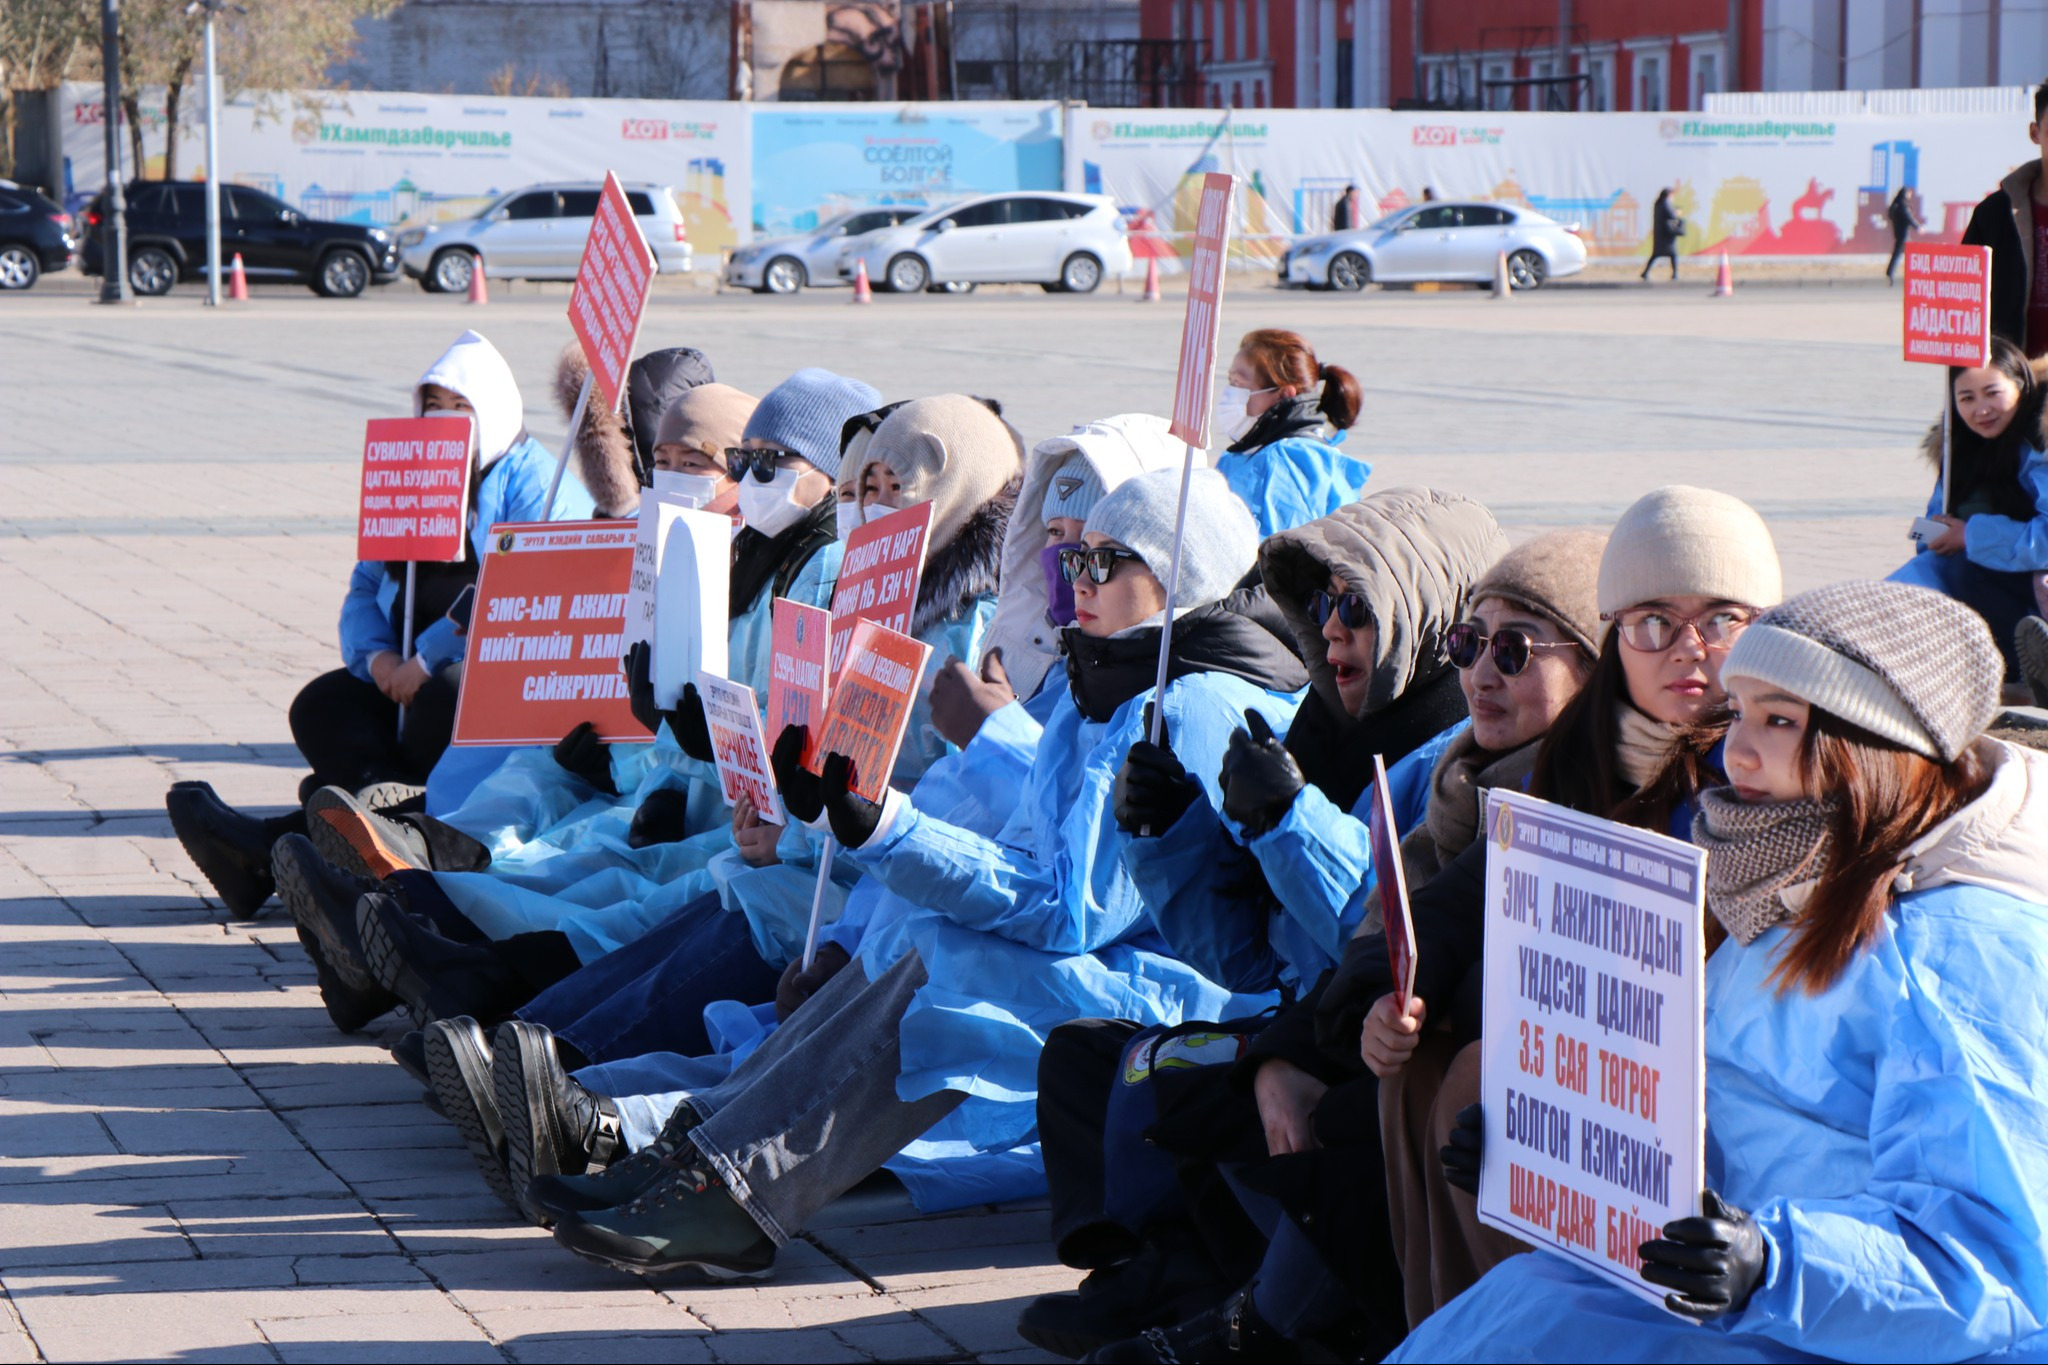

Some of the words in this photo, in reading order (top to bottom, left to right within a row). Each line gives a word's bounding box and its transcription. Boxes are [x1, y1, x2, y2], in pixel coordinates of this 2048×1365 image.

[626, 119, 665, 138] ХОТ
[1416, 126, 1455, 144] ХОТ
[864, 144, 953, 163] СОЁЛТОЙ
[1910, 254, 1930, 275] БИД
[1932, 255, 1982, 277] АЮУЛТАЙ,
[1910, 279, 1936, 299] ХҮНД
[1937, 281, 1982, 302] НӨХЦӨЛД
[1909, 303, 1982, 337] АЙДАСТАЙ
[1909, 339, 1952, 357] АЖИЛЛАЖ
[1954, 341, 1981, 360] БАЙНА
[367, 440, 423, 461] СУВИЛАГЧ
[426, 440, 465, 460] ӨГЛӨӨ
[365, 470, 402, 490] ЦАГТАА
[403, 467, 461, 489] БУУДАГГҮЙ,
[363, 517, 417, 537] ХАЛШИРЧ
[419, 514, 457, 537] БАЙНА
[549, 535, 582, 546] МЭНДИЙН
[585, 533, 624, 544] САЛБАРЫН
[841, 535, 892, 579] СУВИЛАГЧ
[890, 525, 923, 561] НАРТ
[832, 583, 860, 620] ӨМНӨ
[859, 578, 875, 610] НЬ
[877, 570, 904, 605] ХЭН
[904, 567, 914, 598] Ч
[487, 595, 562, 622] ЭМС-ЫН
[478, 630, 573, 662] НИЙГМИЙН
[522, 671, 631, 700] САЙЖРУУЛЪ
[774, 652, 795, 683] СУУРЬ
[795, 659, 822, 691] ЦАЛИНГ
[1502, 866, 1541, 934] ЭМЧ,
[1551, 882, 1683, 978] АЖИЛТНУУДЫН
[1518, 944, 1587, 1020] ҮНДСЭН
[1596, 972, 1665, 1048] ЦАЛИНГ
[1519, 1019, 1545, 1078] 3.5
[1555, 1032, 1589, 1097] САЯ
[1599, 1048, 1661, 1125] ТӨГРӨГ
[1506, 1087, 1571, 1164] БОЛГОН
[1581, 1118, 1673, 1208] НЭМЭХИЙГ
[1510, 1162, 1597, 1252] ШААРДАЖ
